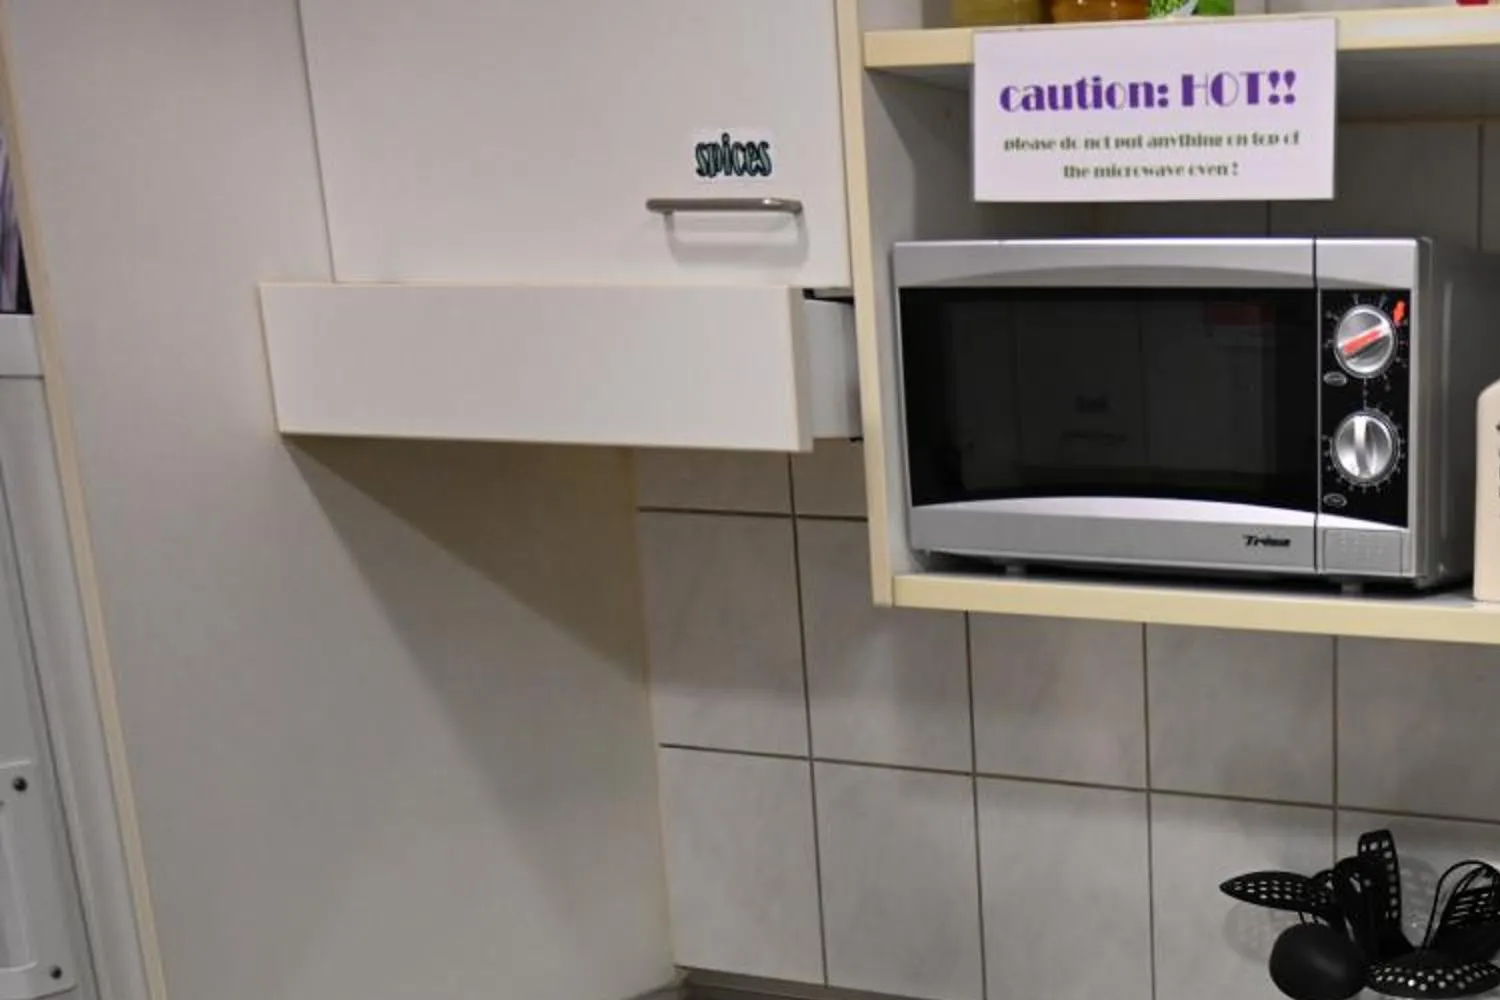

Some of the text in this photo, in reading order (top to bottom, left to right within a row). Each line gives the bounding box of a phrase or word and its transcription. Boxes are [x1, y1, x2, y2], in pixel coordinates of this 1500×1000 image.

[999, 69, 1296, 112] caution: HOT!!
[695, 132, 773, 178] spices
[1004, 130, 1299, 151] please do not put anything on top of
[1064, 164, 1089, 178] the
[1093, 163, 1185, 178] microwave
